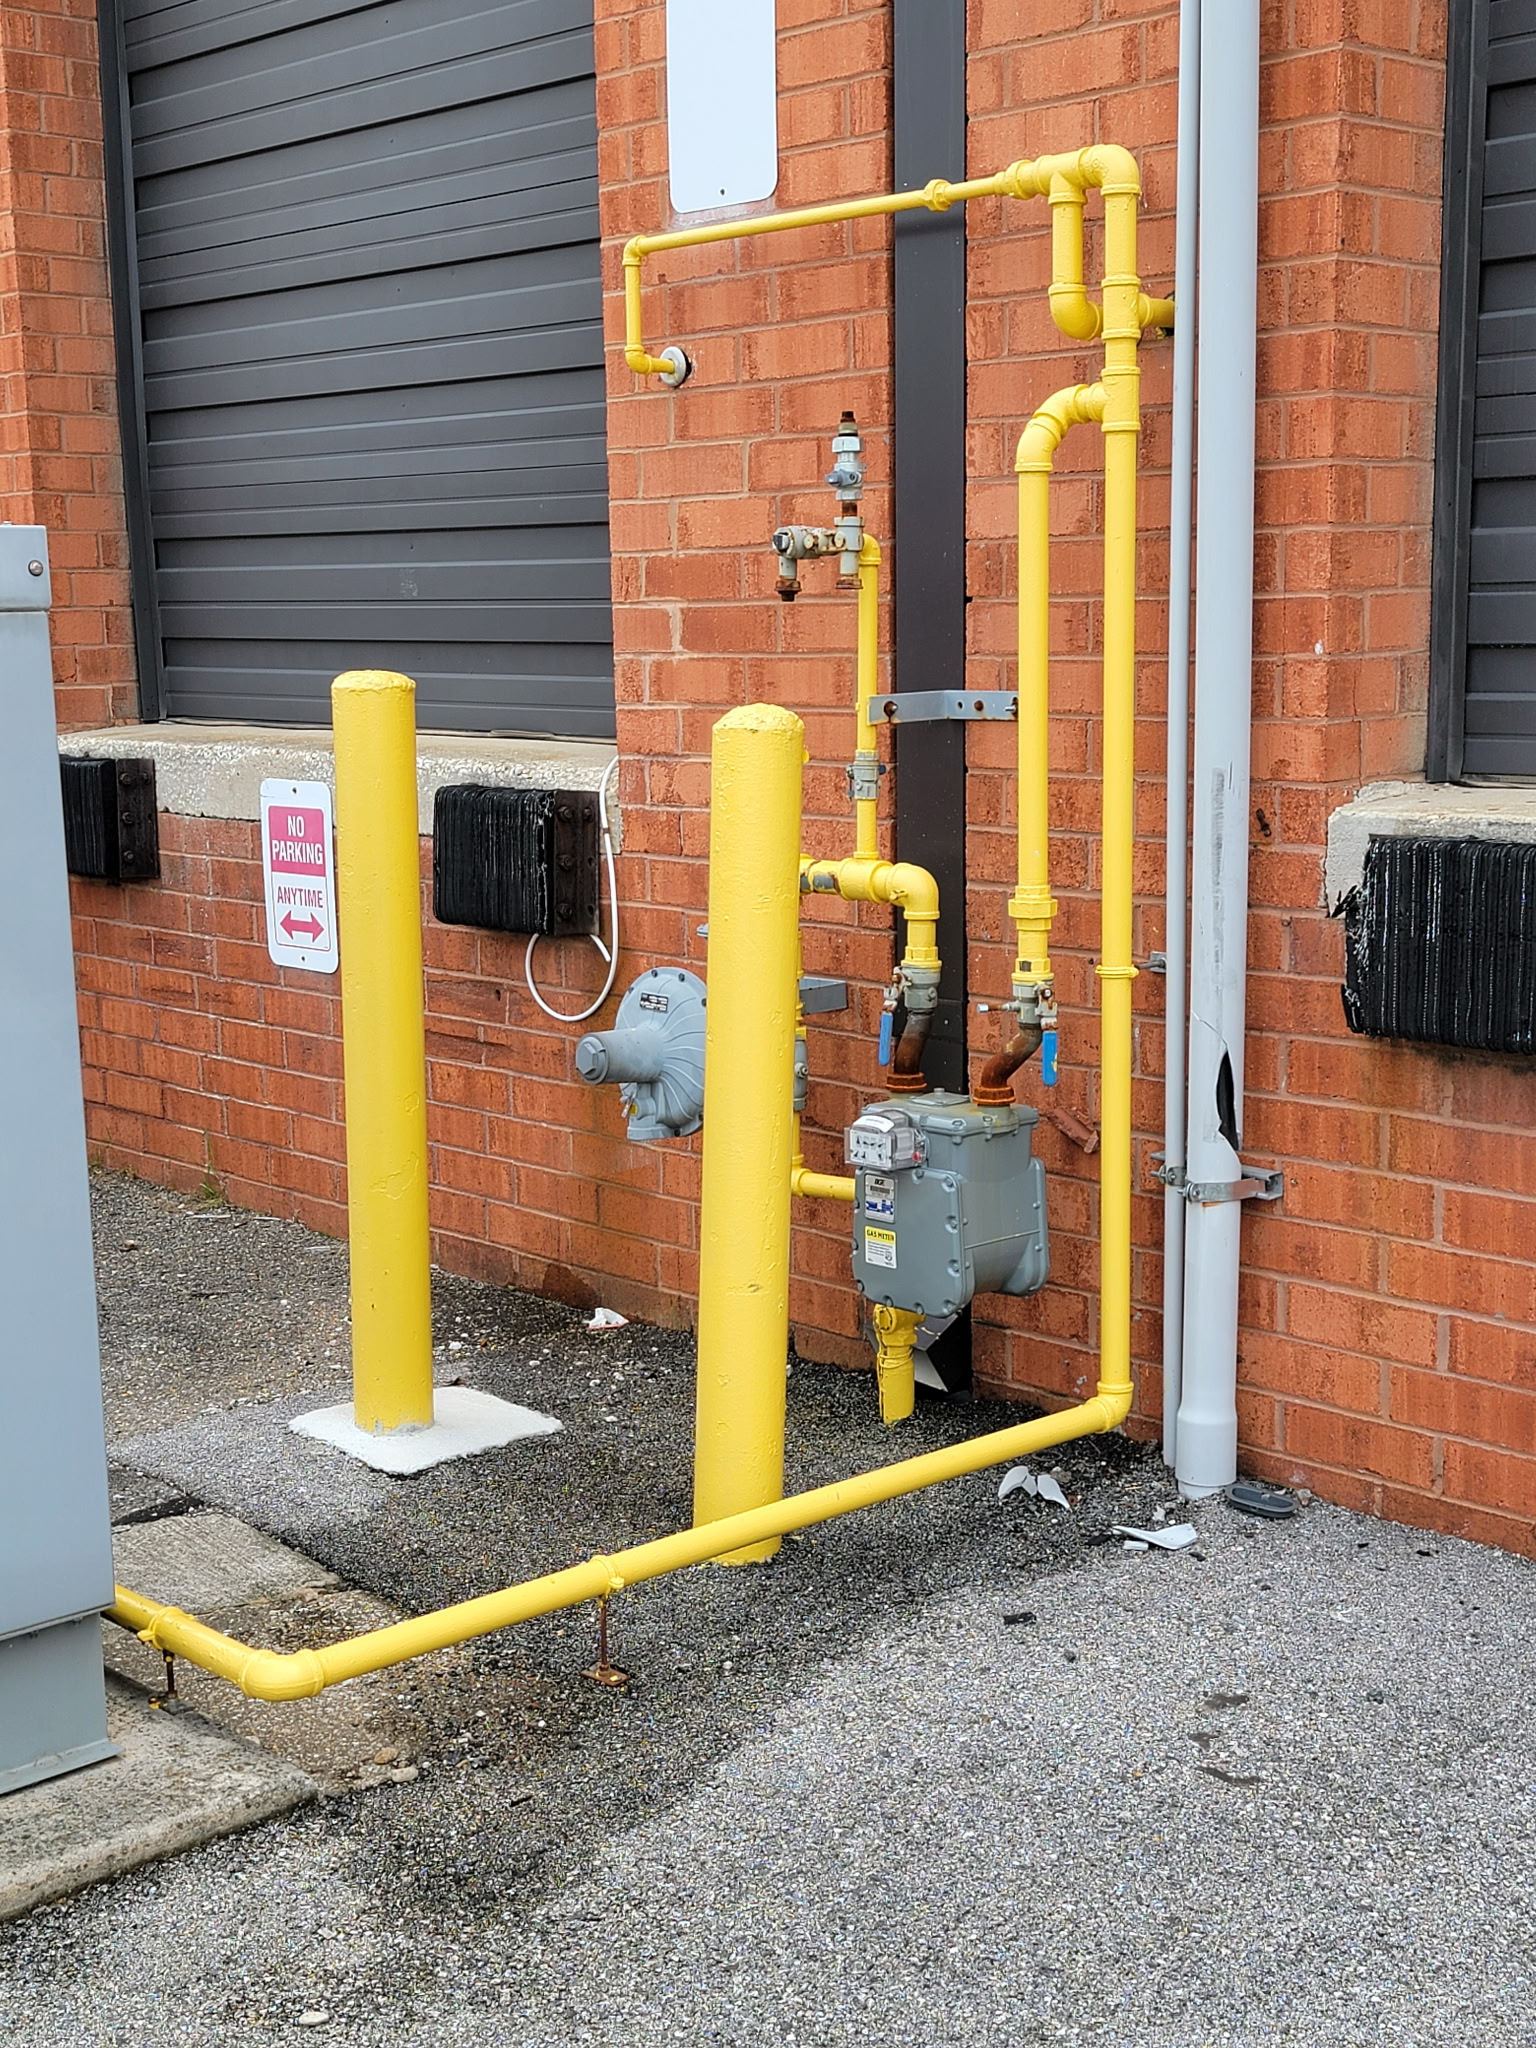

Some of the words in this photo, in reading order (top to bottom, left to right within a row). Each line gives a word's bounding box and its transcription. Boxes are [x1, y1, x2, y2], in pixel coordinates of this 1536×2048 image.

[287, 815, 305, 838] NO
[272, 839, 324, 865] PARKING
[277, 886, 324, 908] ANYTIME
[866, 1229, 877, 1238] GAS
[878, 1232, 895, 1241] METER
